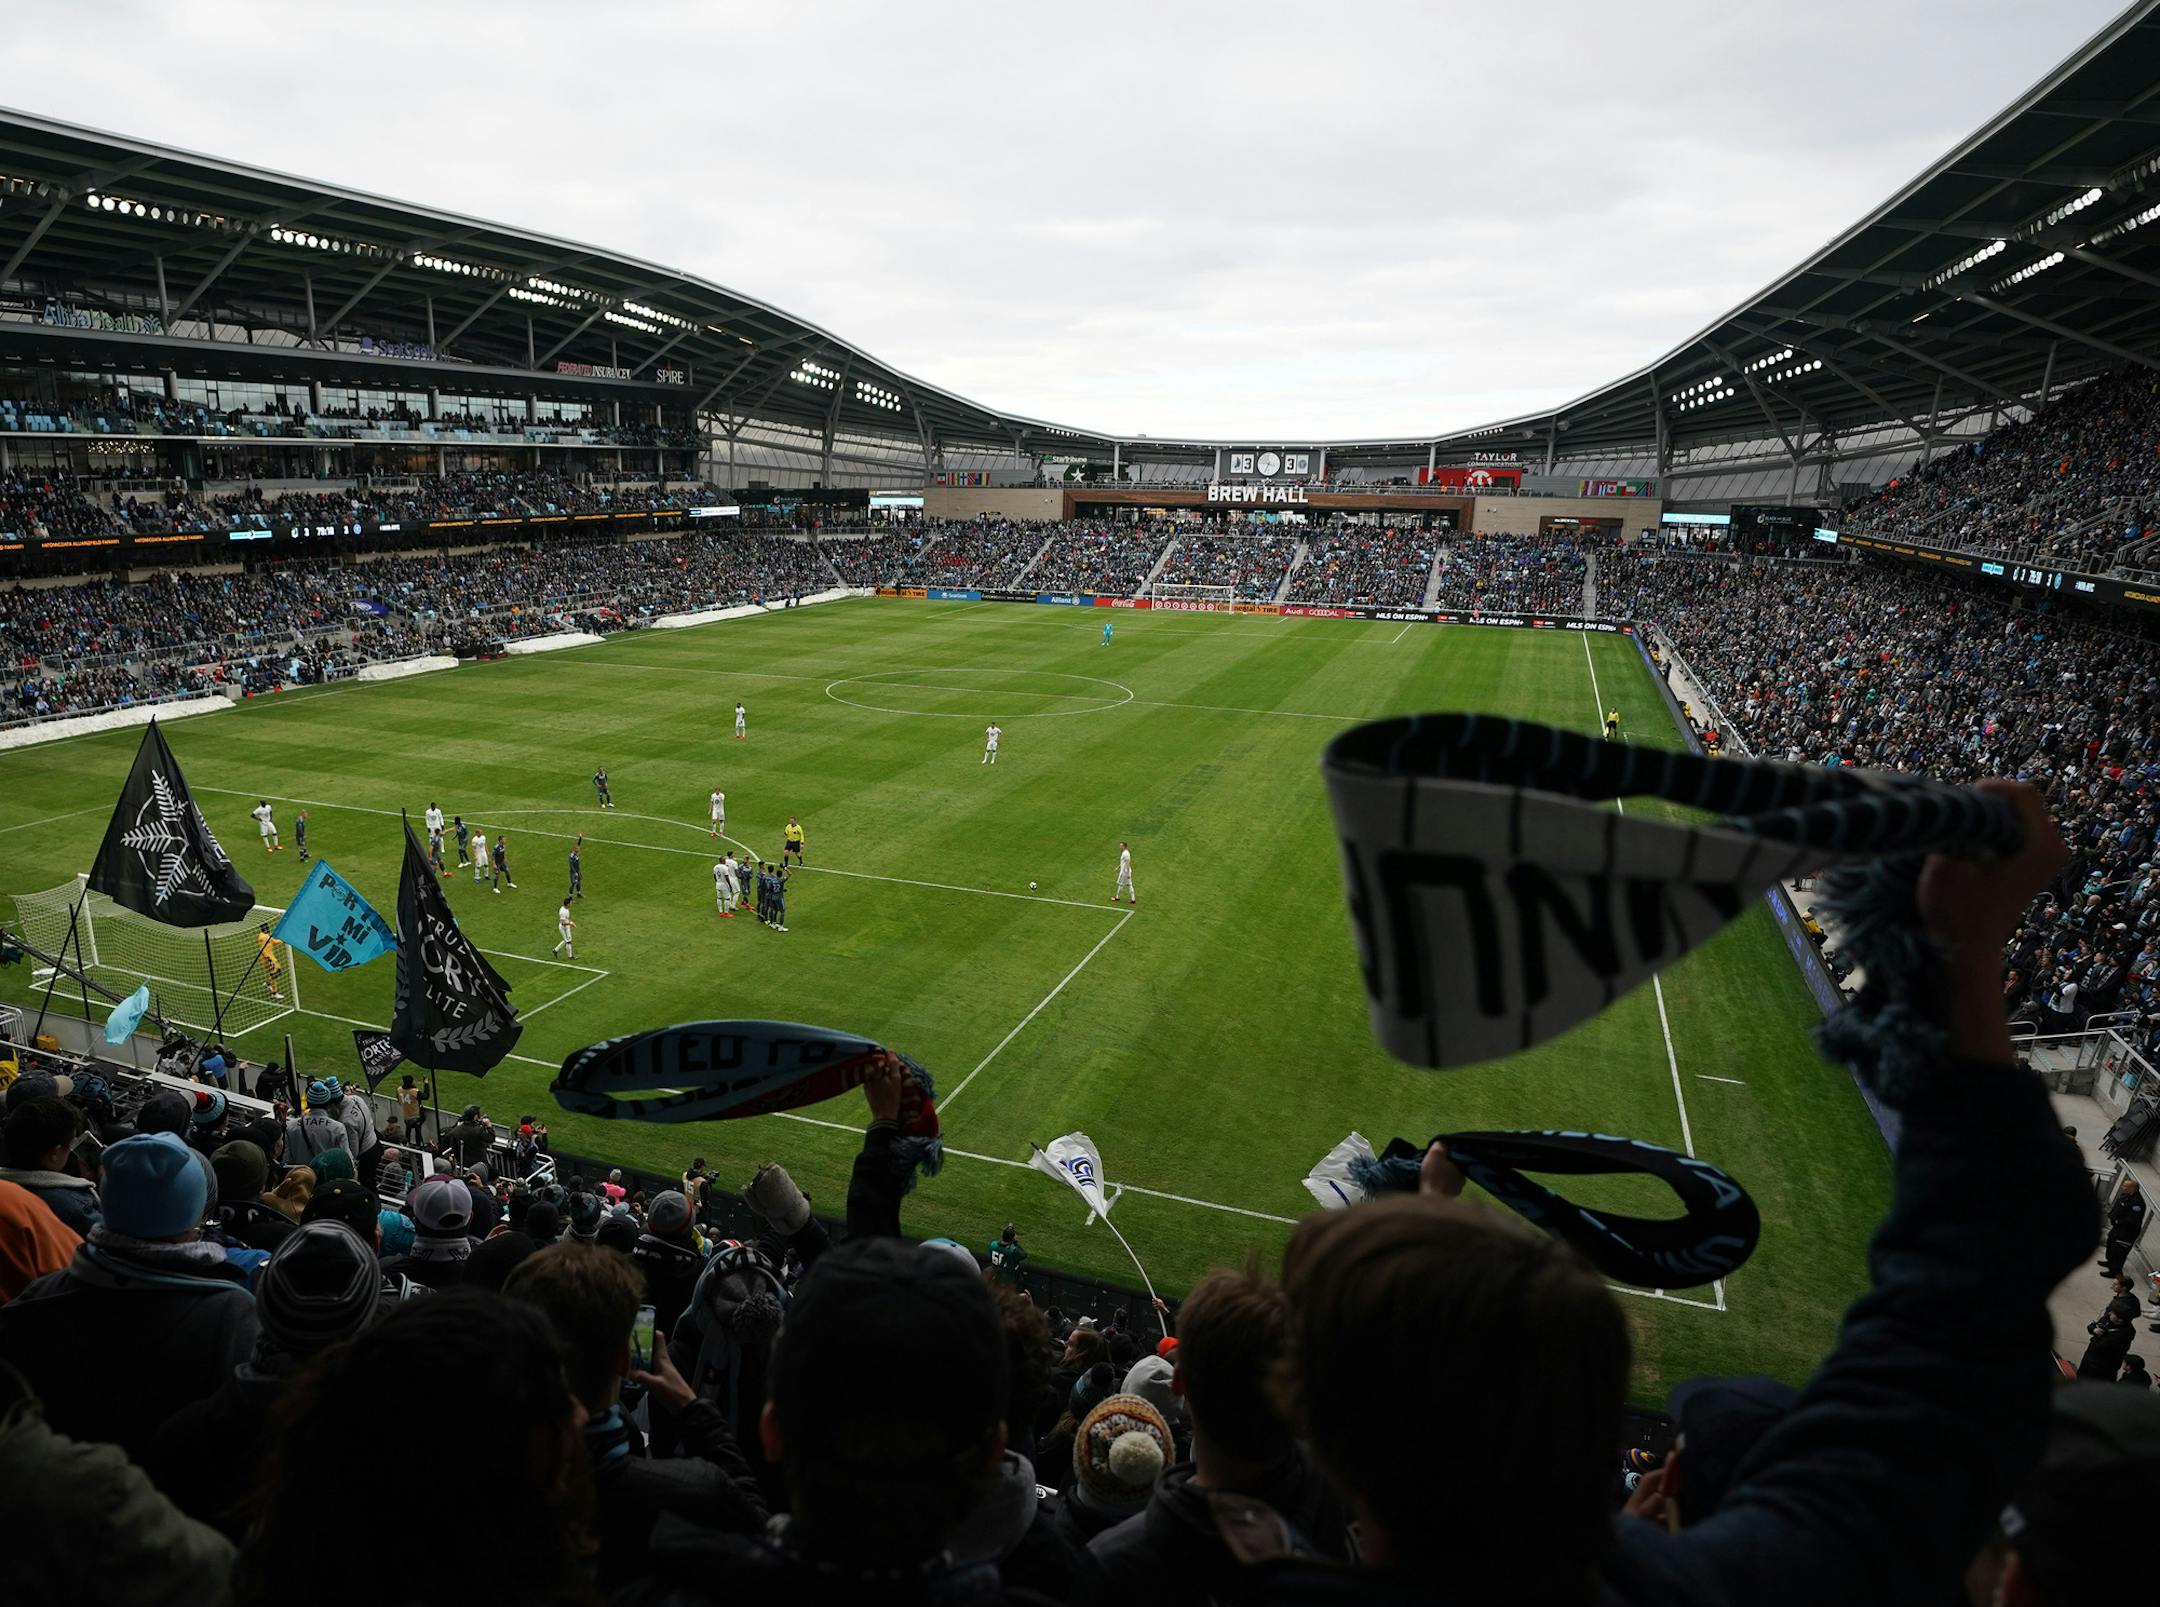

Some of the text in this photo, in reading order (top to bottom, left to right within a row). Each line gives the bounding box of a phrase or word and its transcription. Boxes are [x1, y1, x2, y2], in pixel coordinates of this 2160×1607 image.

[656, 368, 685, 384] SPIRE
[1475, 452, 1516, 461] TAYLOR
[1244, 457, 1252, 470] 3
[1287, 458, 1294, 470] 3
[1208, 486, 1309, 503] BREW HALL
[1050, 596, 1070, 604] Allianz
[1393, 612, 1404, 620] ON
[422, 975, 467, 1019] LITE
[296, 1117, 331, 1127] STAFF
